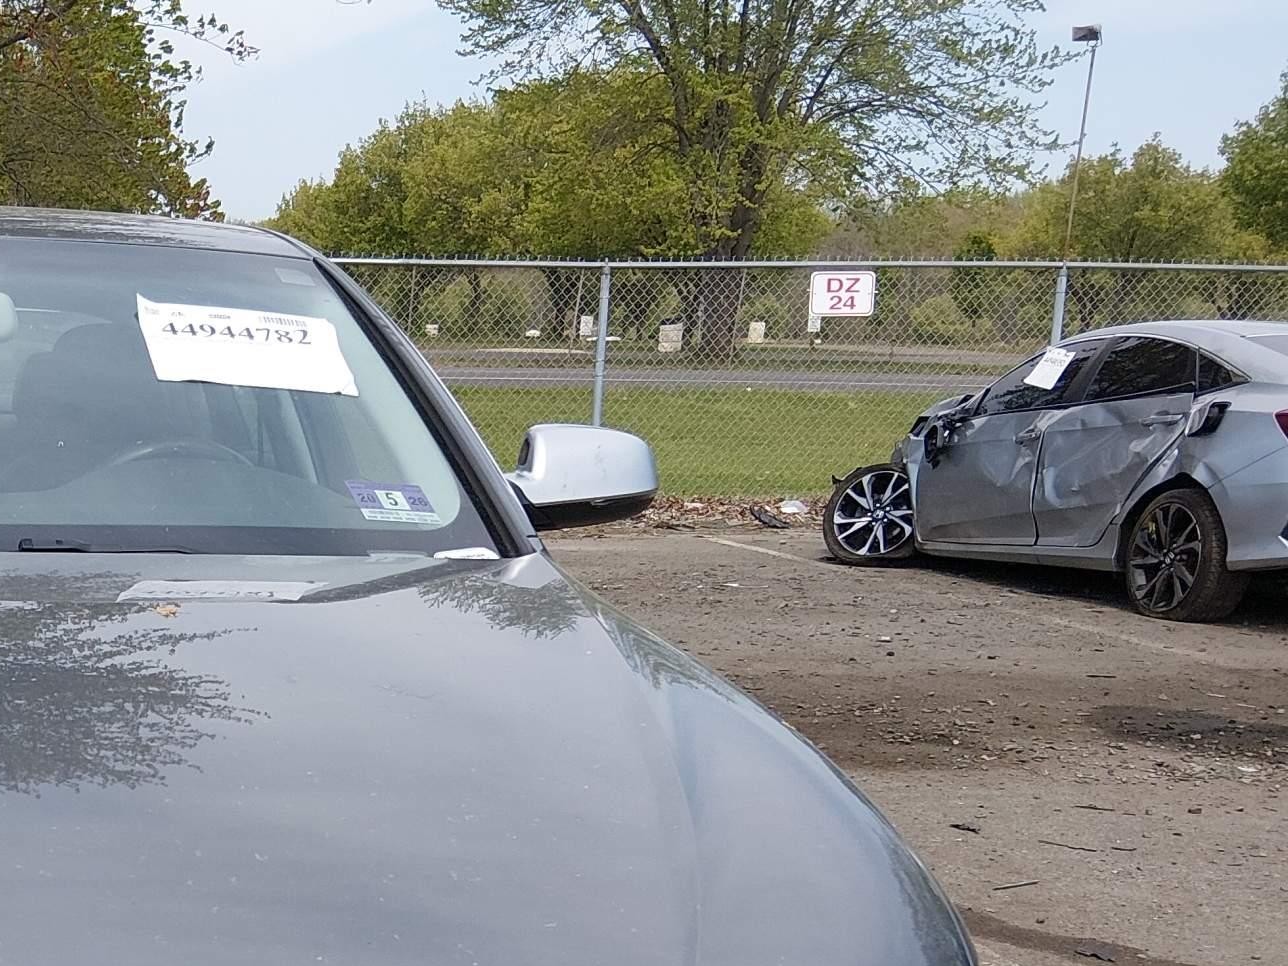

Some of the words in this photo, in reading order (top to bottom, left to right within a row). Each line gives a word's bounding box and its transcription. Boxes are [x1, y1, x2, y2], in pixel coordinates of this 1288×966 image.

[826, 278, 861, 293] DZ
[828, 295, 857, 310] 24
[162, 321, 312, 345] 44944782
[356, 493, 377, 503] 20
[385, 492, 399, 506] 5
